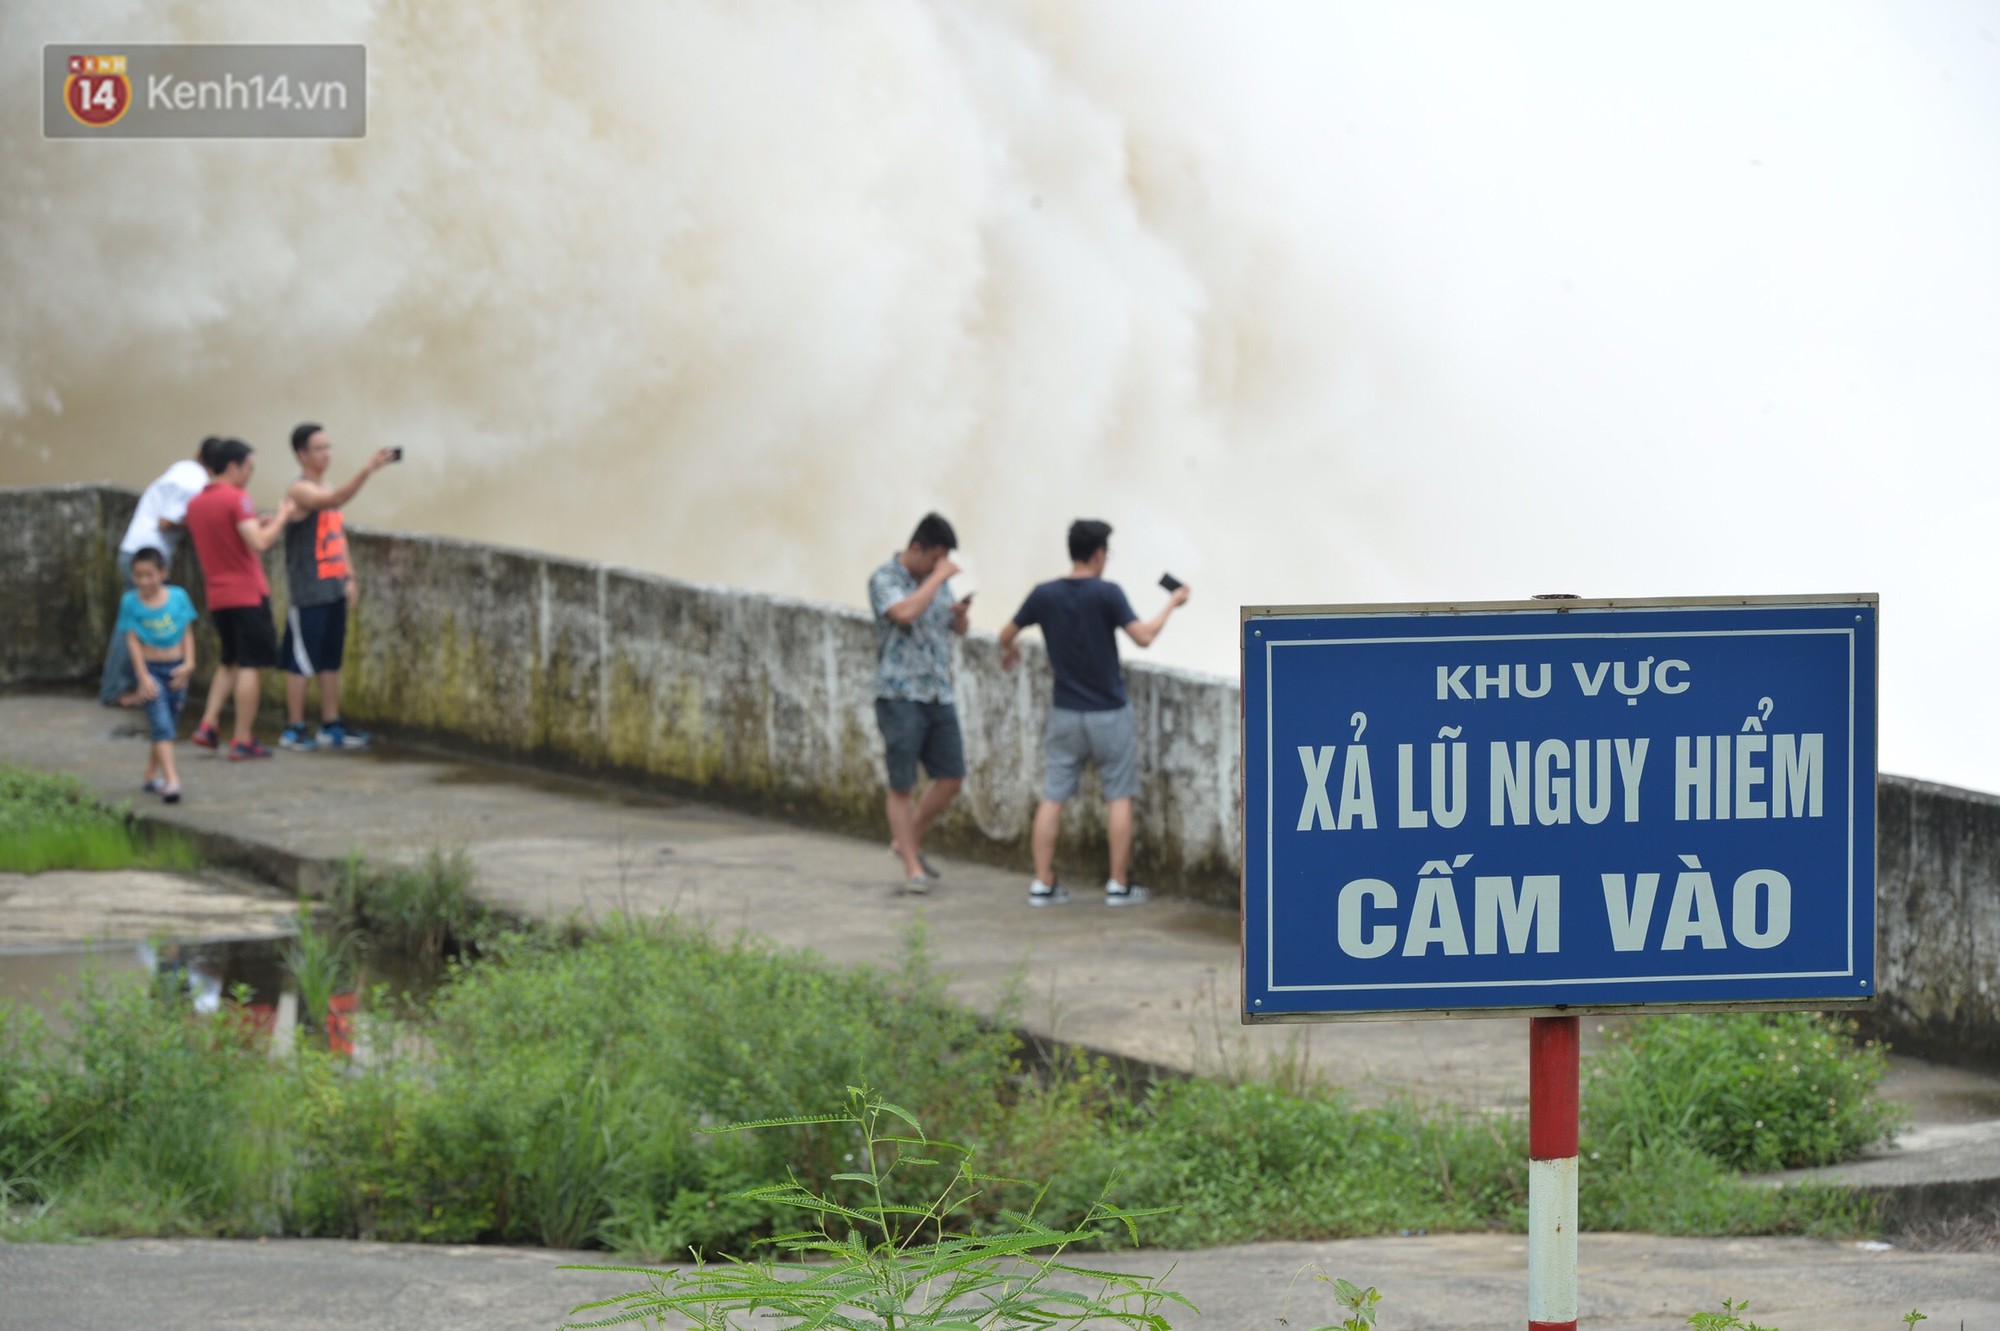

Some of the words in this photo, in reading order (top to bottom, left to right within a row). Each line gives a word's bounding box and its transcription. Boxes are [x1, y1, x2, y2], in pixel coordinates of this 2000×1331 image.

[1436, 663, 1552, 700] KHU
[1572, 656, 1691, 706] VỰC
[1296, 711, 1378, 831] XẢ
[1398, 725, 1468, 829] LŨ
[1490, 737, 1650, 826] NGUY
[1675, 697, 1824, 820] HIỂM
[1337, 853, 1561, 959] CẤM
[1601, 854, 1792, 952] VÀO
